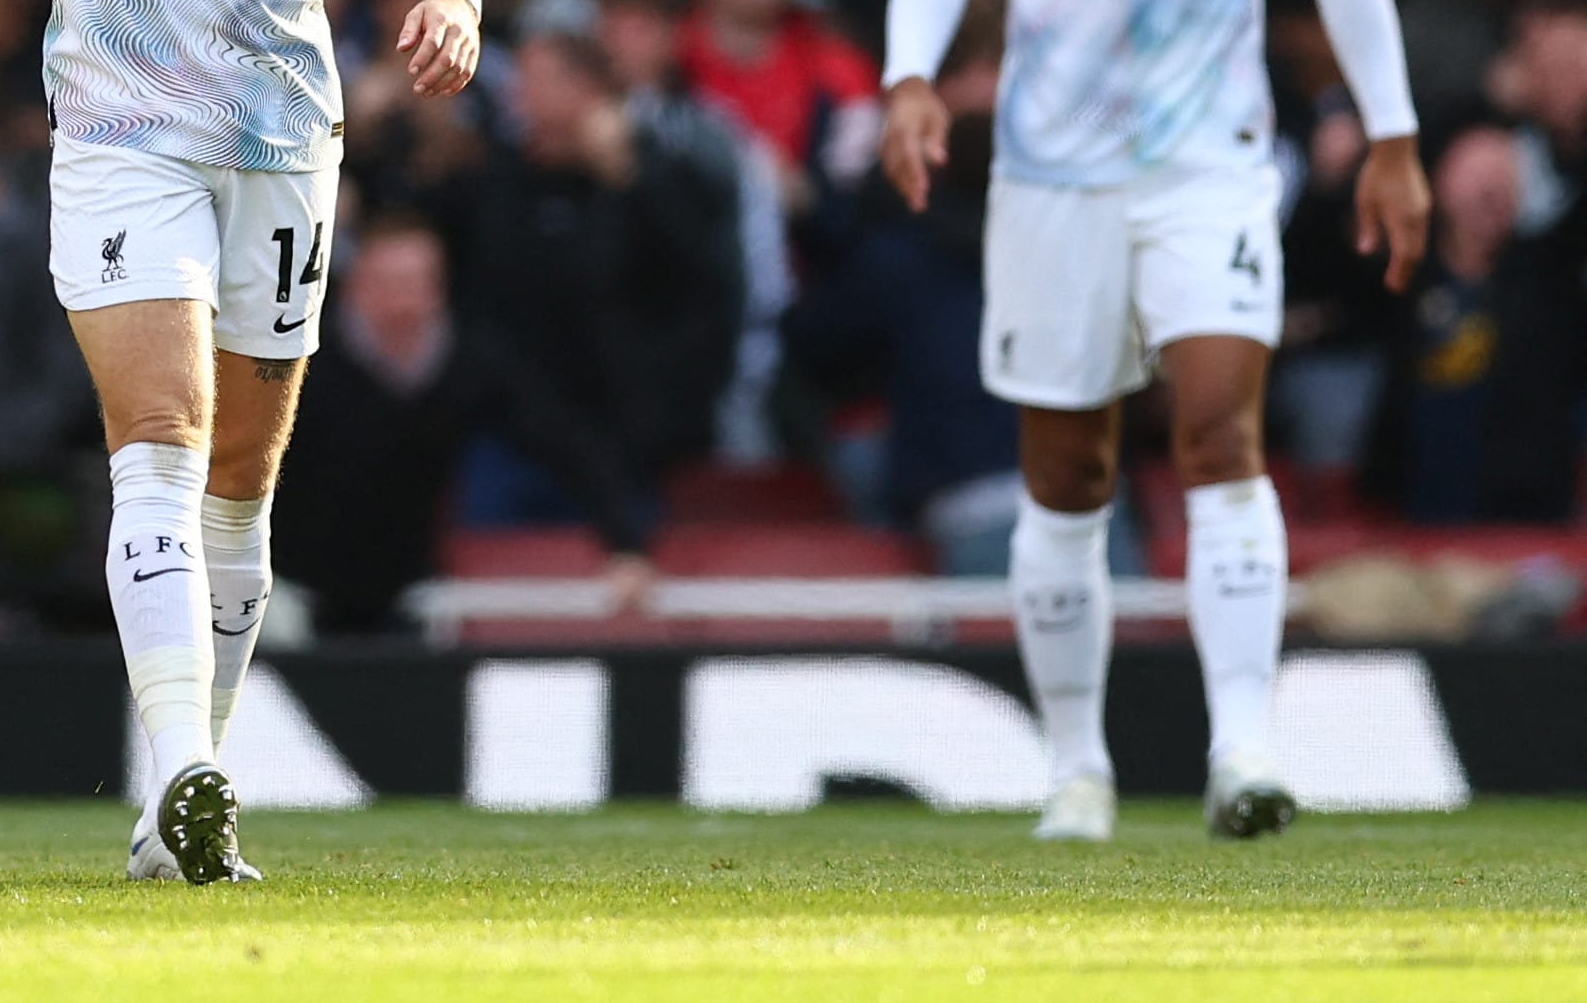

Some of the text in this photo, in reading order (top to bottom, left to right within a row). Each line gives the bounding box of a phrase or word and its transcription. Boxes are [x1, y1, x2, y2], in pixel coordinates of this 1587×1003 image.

[102, 268, 129, 283] LFC
[271, 221, 323, 302] 14
[1228, 233, 1261, 285] 4
